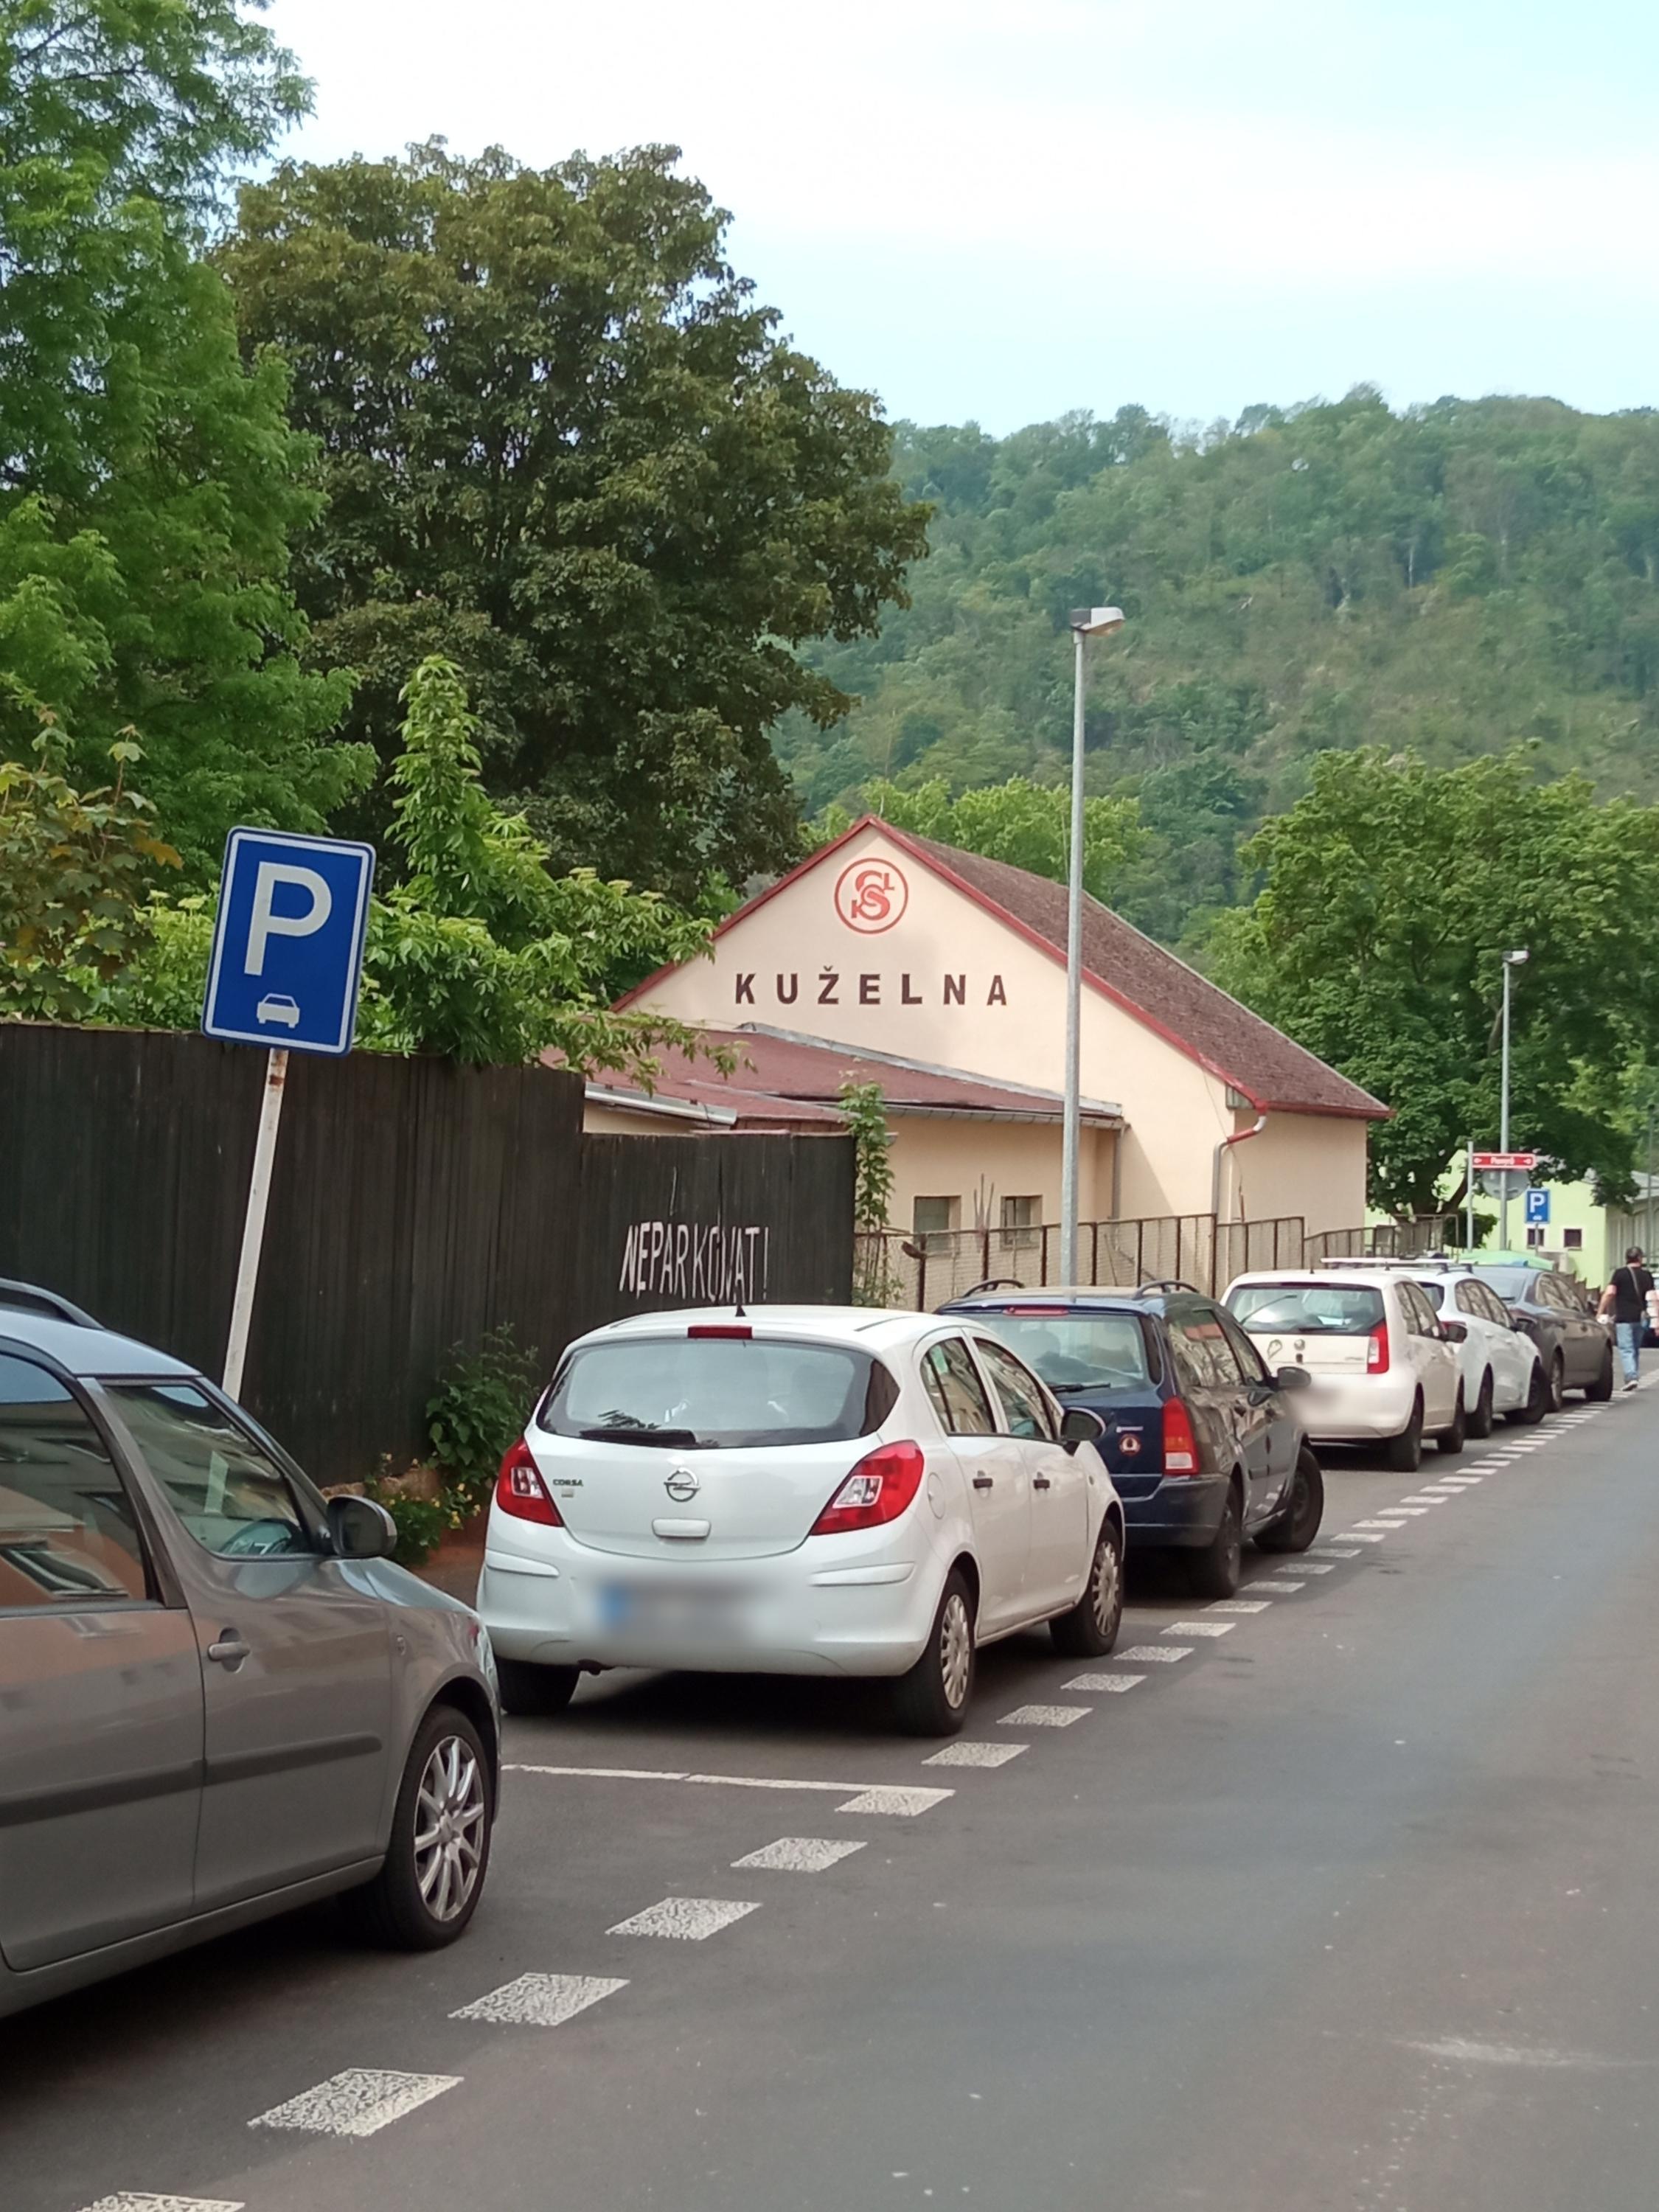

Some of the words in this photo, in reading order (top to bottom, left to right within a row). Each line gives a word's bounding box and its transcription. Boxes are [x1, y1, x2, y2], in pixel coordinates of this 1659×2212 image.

[244, 861, 332, 976] P
[734, 965, 1007, 1006] KUŽELNA
[1530, 1193, 1545, 1213] P
[552, 1478, 584, 1486] CORSA
